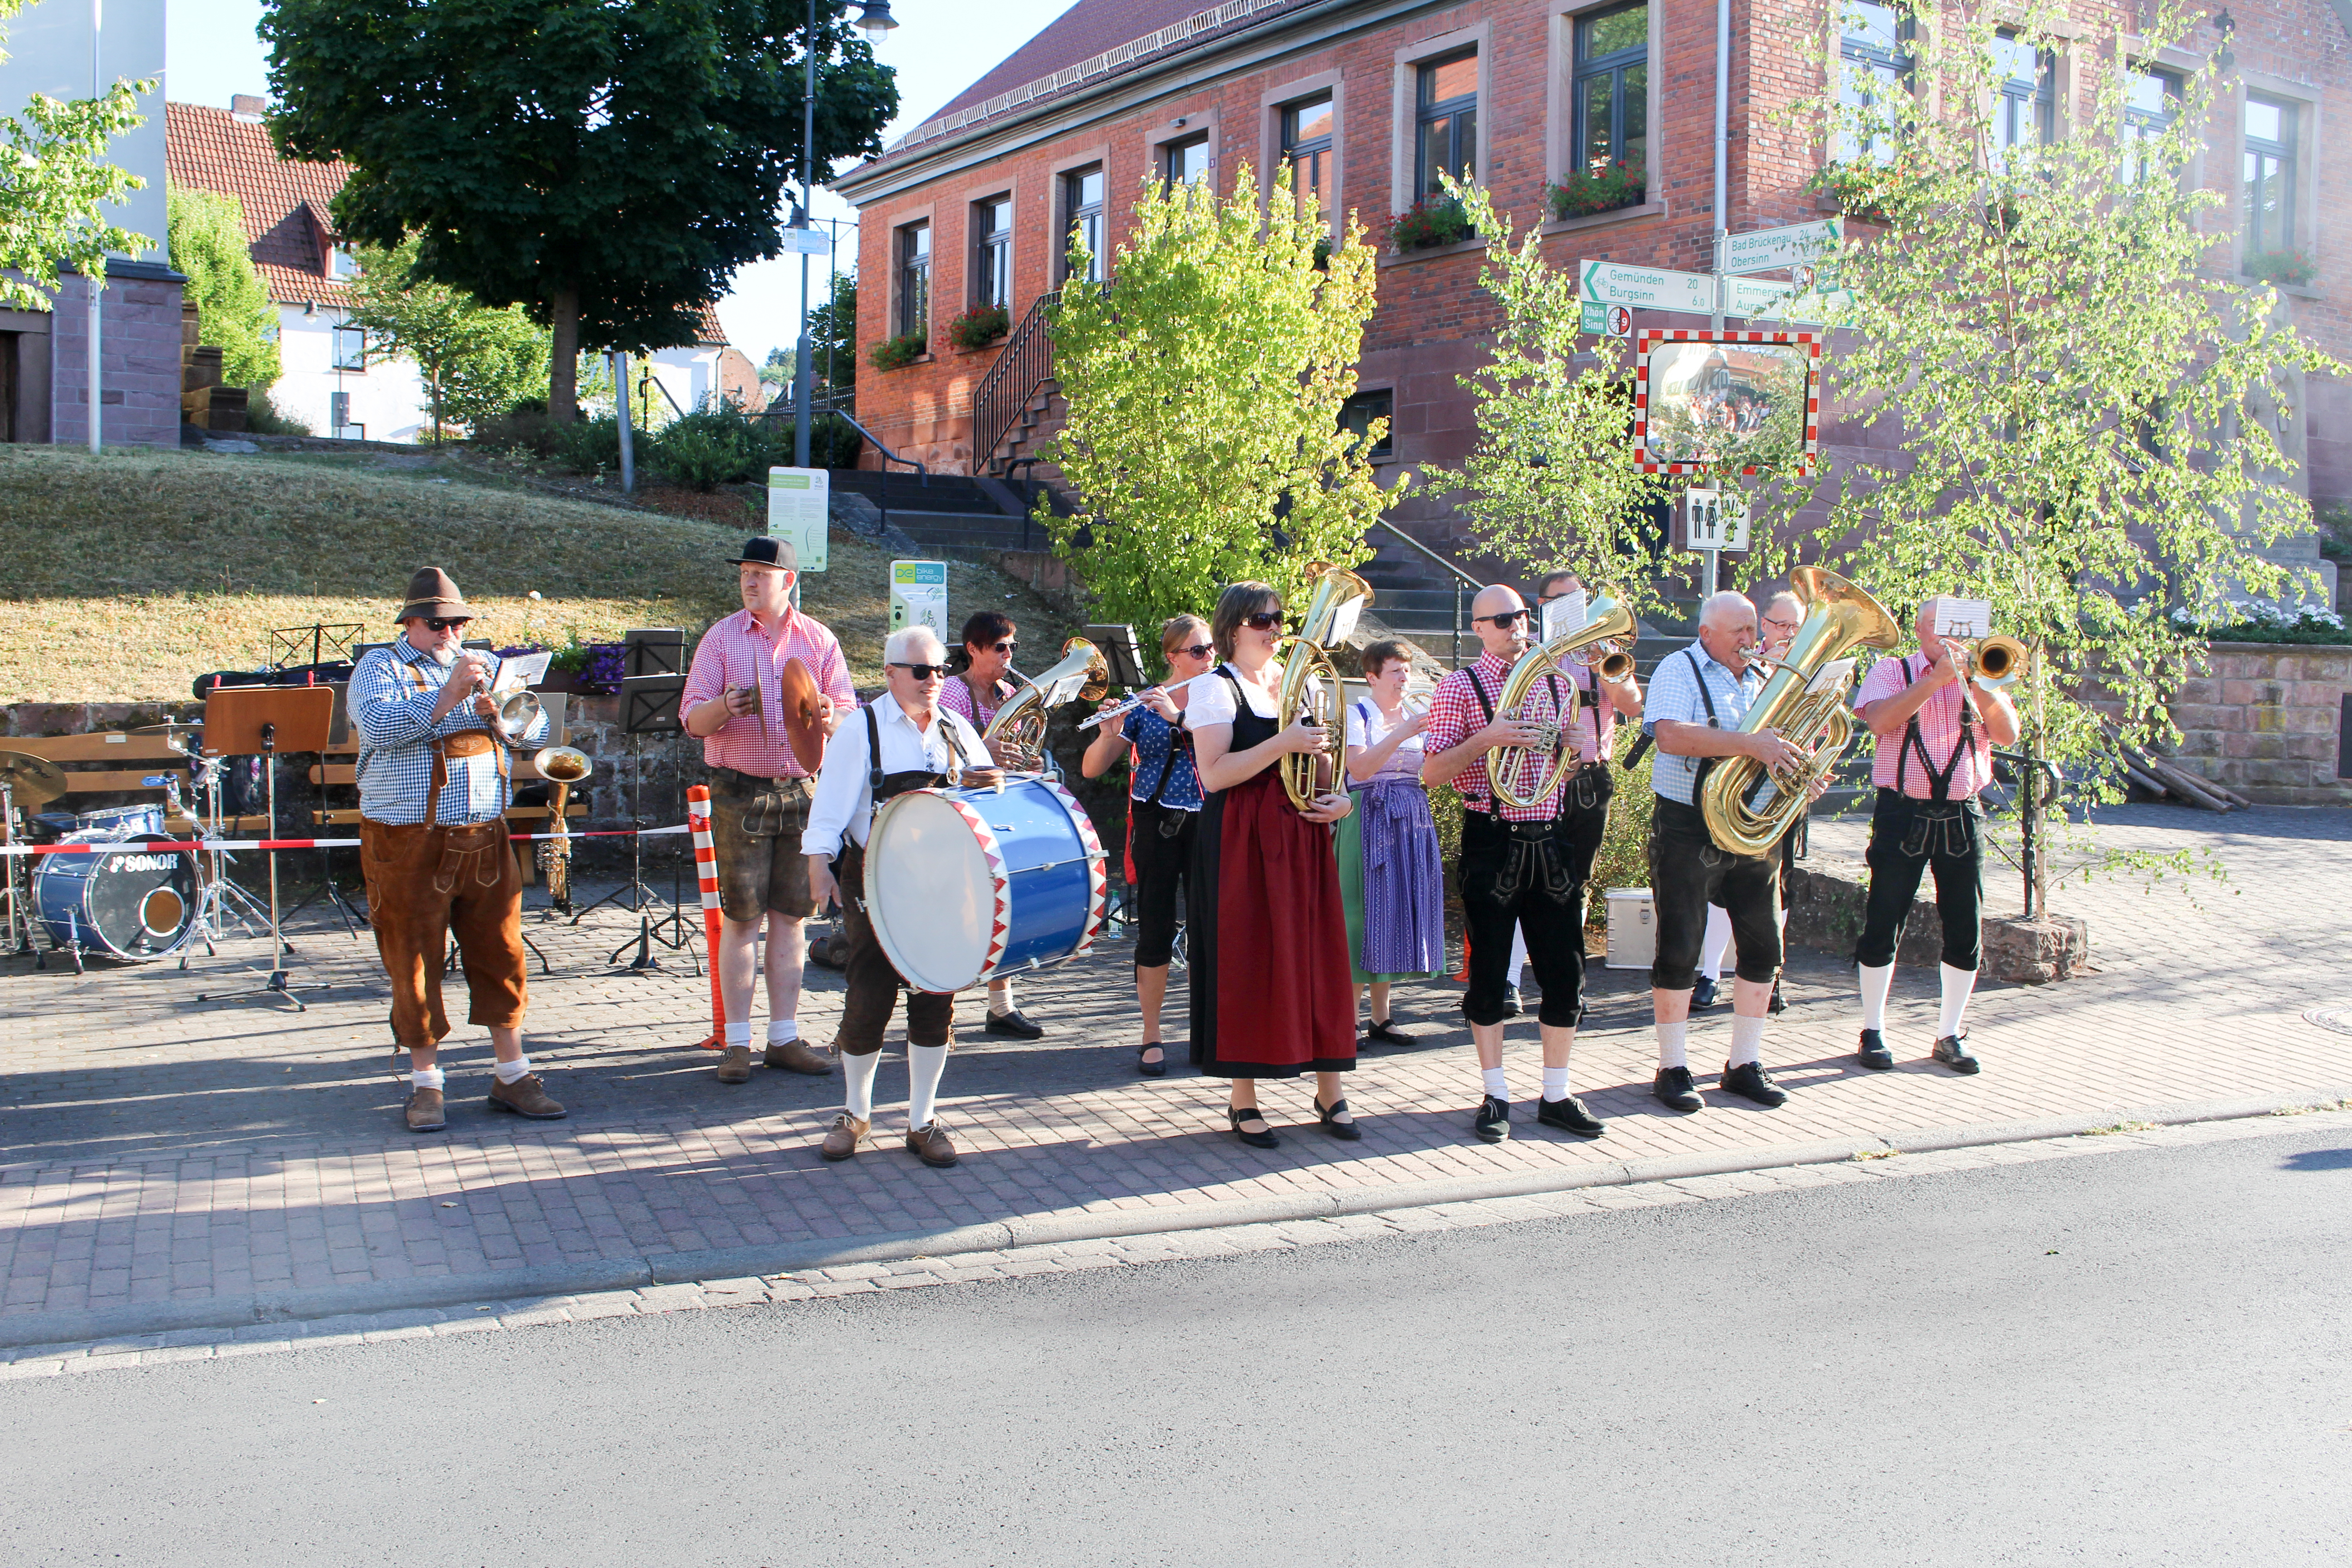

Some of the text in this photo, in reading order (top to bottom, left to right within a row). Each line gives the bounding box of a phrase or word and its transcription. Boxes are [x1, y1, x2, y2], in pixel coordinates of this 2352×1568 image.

[1732, 229, 1809, 251] Bad Brückenau 24
[1731, 253, 1769, 267] Obersinn
[1610, 270, 1698, 289] Gemünden 20
[1610, 286, 1705, 307] Burgsinn 6,0
[1584, 305, 1604, 318] Rhön
[1585, 318, 1604, 331] Sinn
[1622, 317, 1628, 327] 9
[124, 853, 178, 872] SONOR
